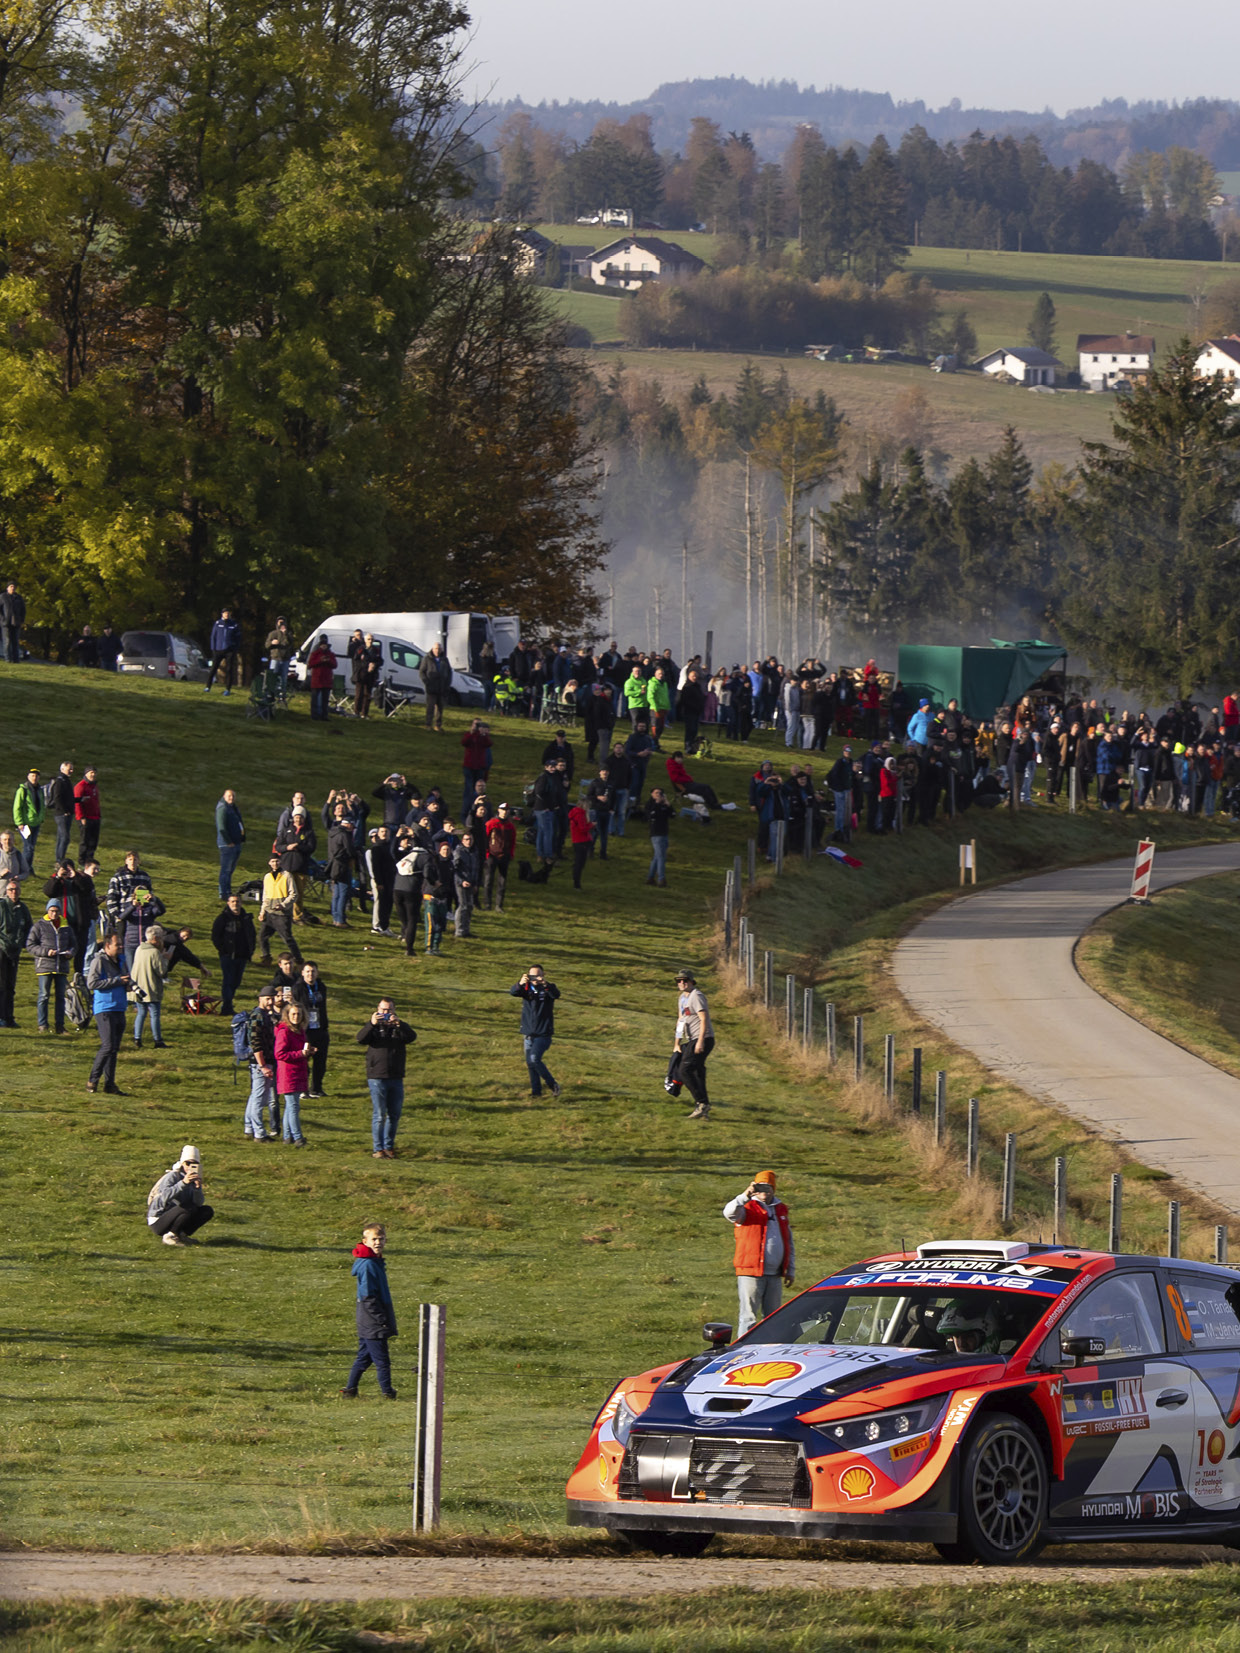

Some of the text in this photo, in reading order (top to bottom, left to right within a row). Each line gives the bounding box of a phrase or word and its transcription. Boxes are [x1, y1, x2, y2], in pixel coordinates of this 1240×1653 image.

[905, 1260, 998, 1271] HYUNDAI
[874, 1272, 1034, 1289] FORUM8
[1043, 1273, 1093, 1328] motorsport.hyundai.com
[1166, 1284, 1192, 1341] 8
[769, 1348, 890, 1364] MOBIS
[1131, 1418, 1147, 1428] FUEL
[893, 1437, 928, 1458] PIRELLI
[1197, 1428, 1226, 1467] 10
[1203, 1469, 1217, 1478] YEARS
[1081, 1491, 1181, 1520] HYUNDAI MOBIS
